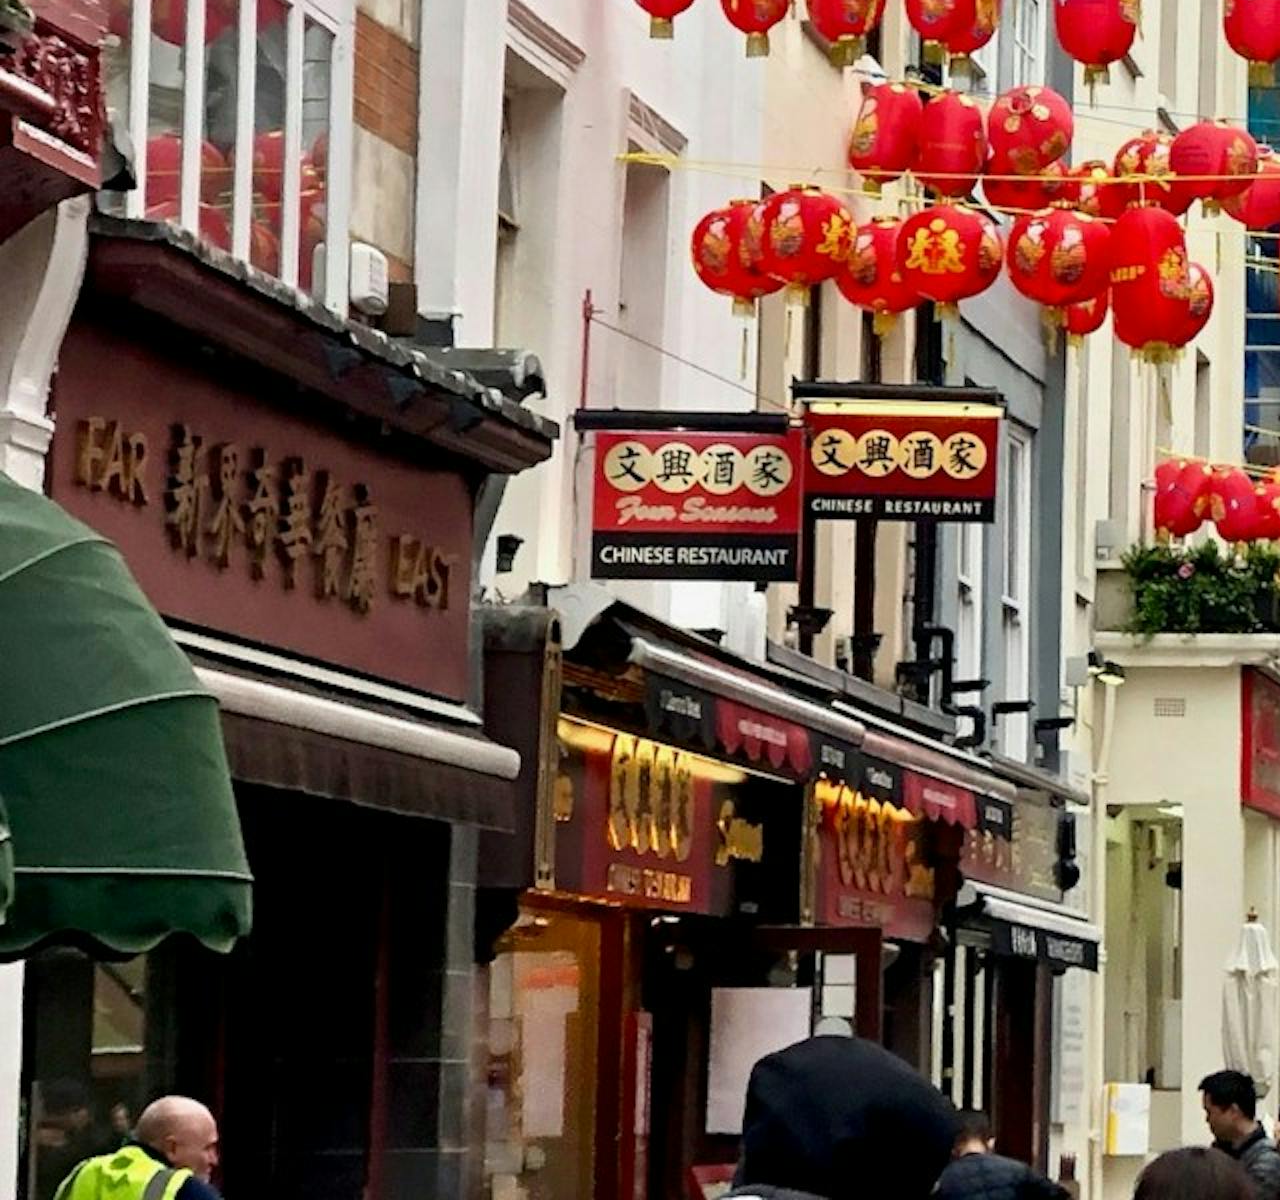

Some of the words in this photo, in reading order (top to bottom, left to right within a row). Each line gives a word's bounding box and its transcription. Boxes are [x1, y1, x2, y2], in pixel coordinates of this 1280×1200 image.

[80, 416, 148, 505] FAR
[611, 444, 785, 488] 文興酒家
[815, 435, 978, 480] 文興酒家
[678, 496, 778, 523] Seasons
[811, 498, 873, 514] CHINESE
[884, 500, 983, 515] RESTAURANT
[393, 533, 460, 610] EAST
[599, 544, 675, 566] CHINESE
[677, 546, 790, 566] RESTAURANT
